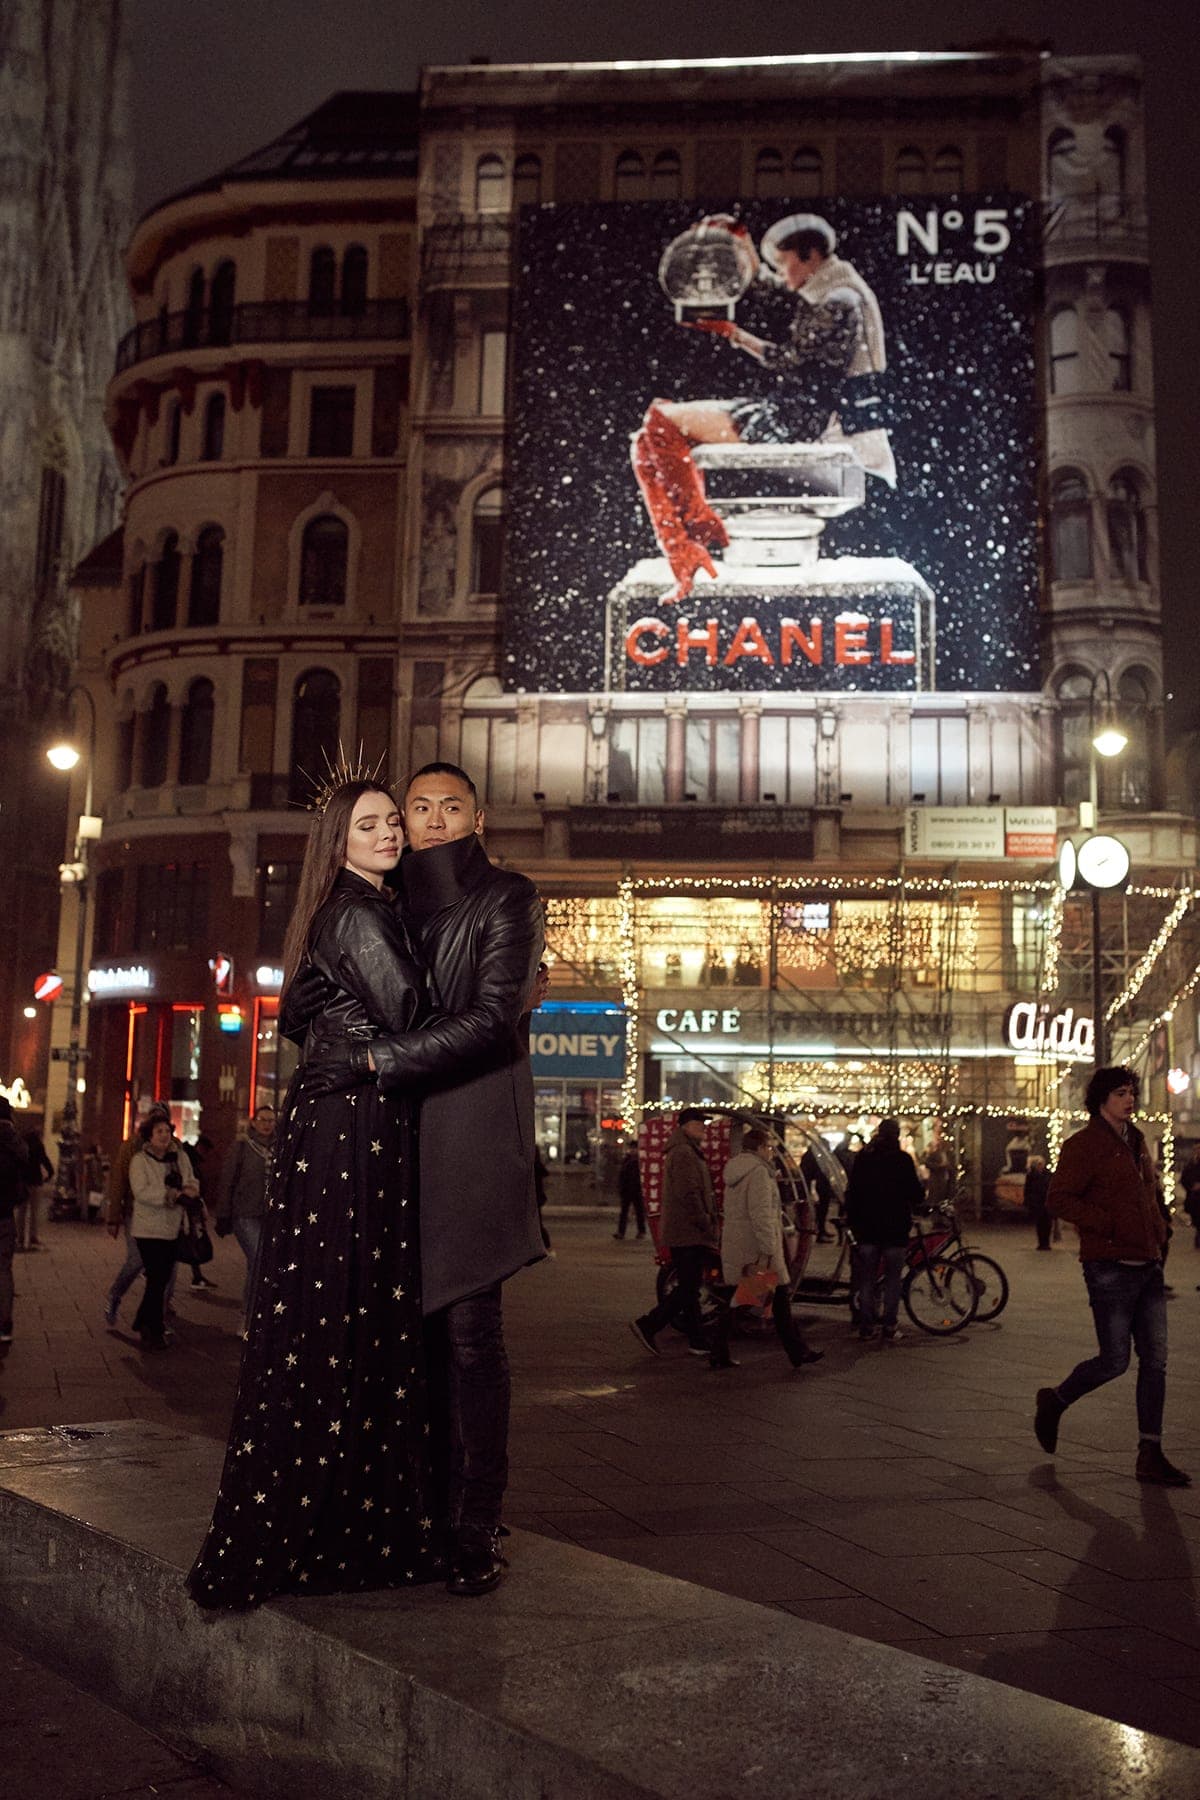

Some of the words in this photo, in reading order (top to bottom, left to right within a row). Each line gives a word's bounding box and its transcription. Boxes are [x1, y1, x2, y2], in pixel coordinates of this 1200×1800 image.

[973, 209, 1011, 255] 5
[910, 262, 996, 284] L'EAU
[625, 613, 916, 666] CHANEL
[655, 1006, 742, 1033] CAFÉ
